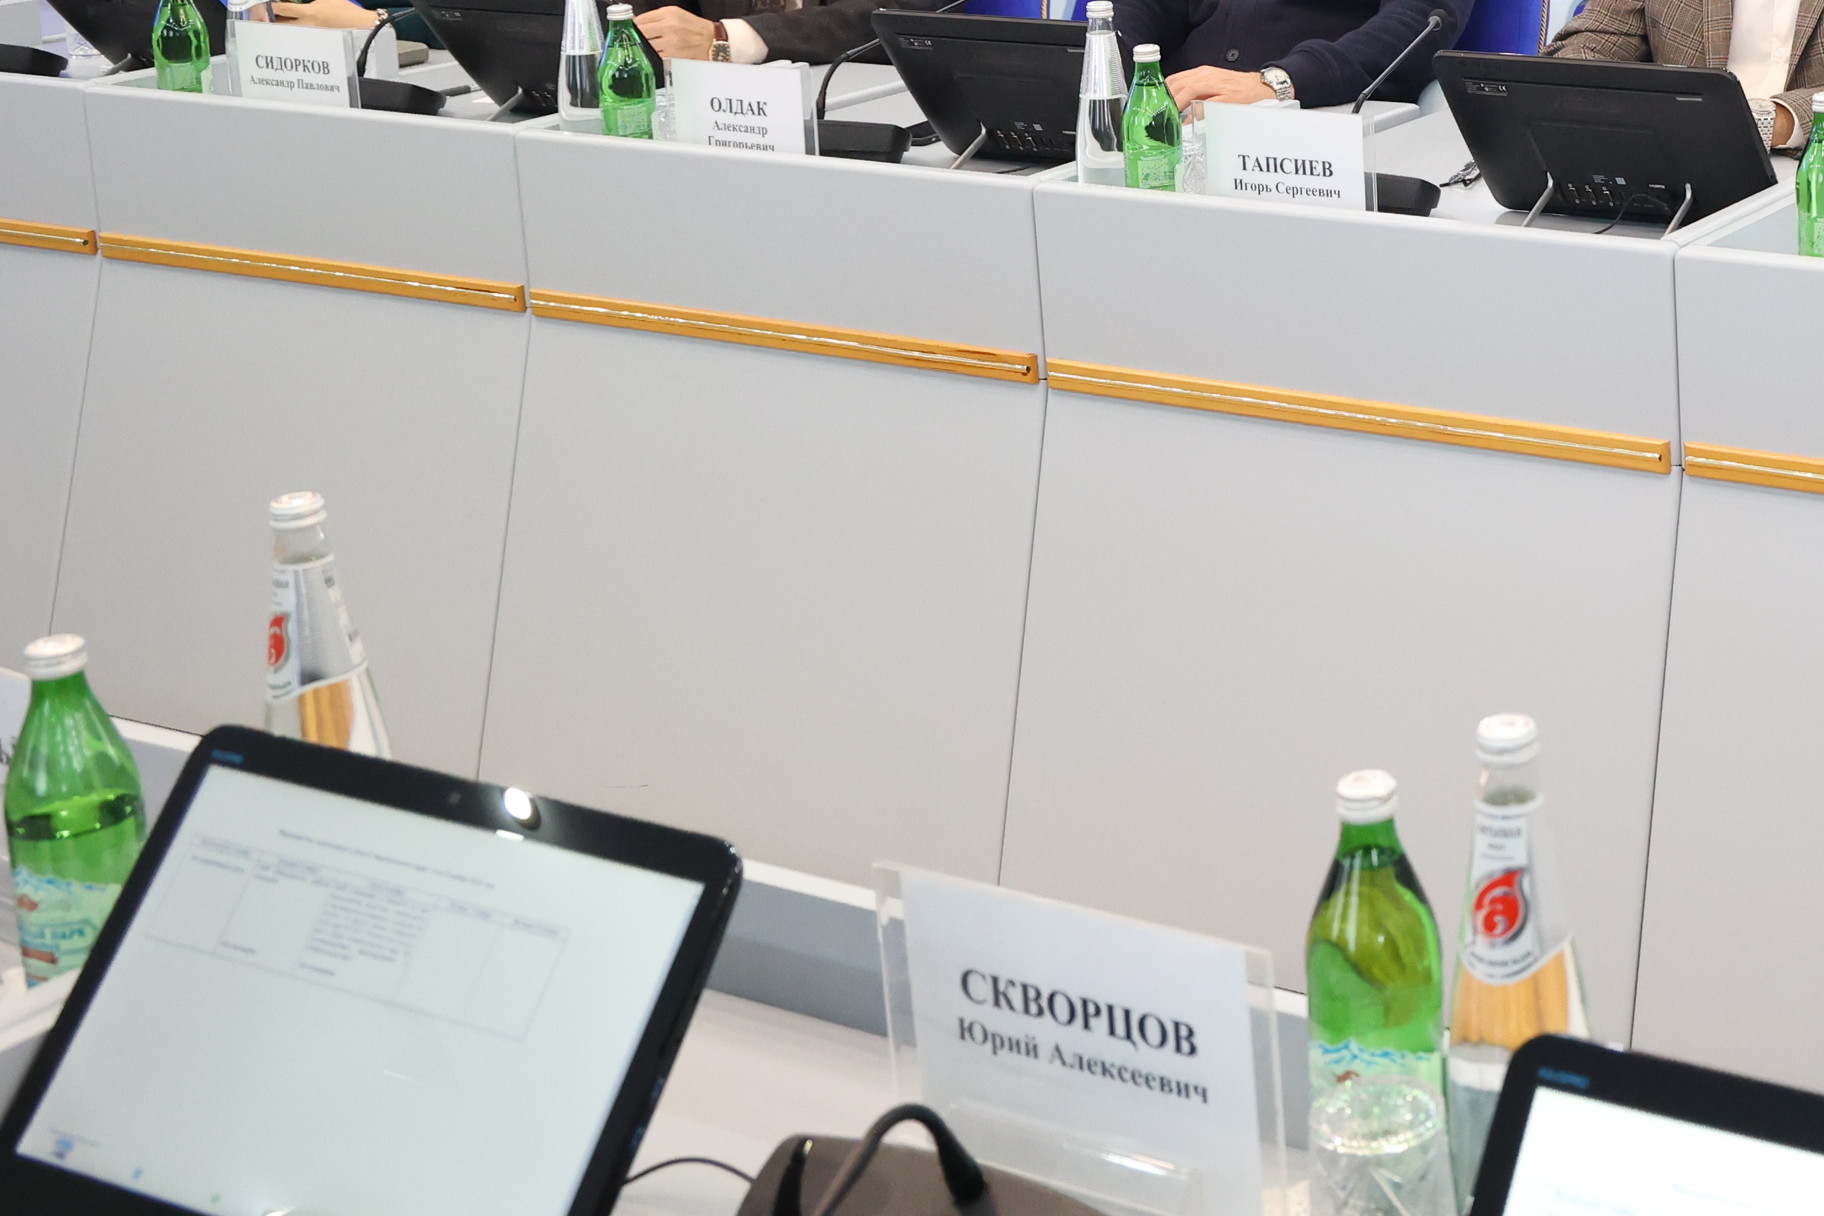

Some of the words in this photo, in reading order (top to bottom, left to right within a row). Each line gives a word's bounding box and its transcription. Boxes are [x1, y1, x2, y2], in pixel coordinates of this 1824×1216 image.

[255, 54, 331, 75] СИДОРКОВ
[249, 75, 295, 91] Александр
[297, 78, 341, 93] Павлович
[709, 96, 768, 117] ОЛДАК
[712, 120, 768, 138] Александр
[707, 135, 775, 152] Григорьевич
[1237, 154, 1334, 178] ТАПСИЕВ
[1233, 178, 1272, 195] Игорь
[1275, 181, 1341, 199] Сергеевич
[959, 968, 1199, 1059] СКВОРЦОВ
[957, 1016, 1040, 1056] Юрий
[1049, 1041, 1209, 1105] Алексеевич
